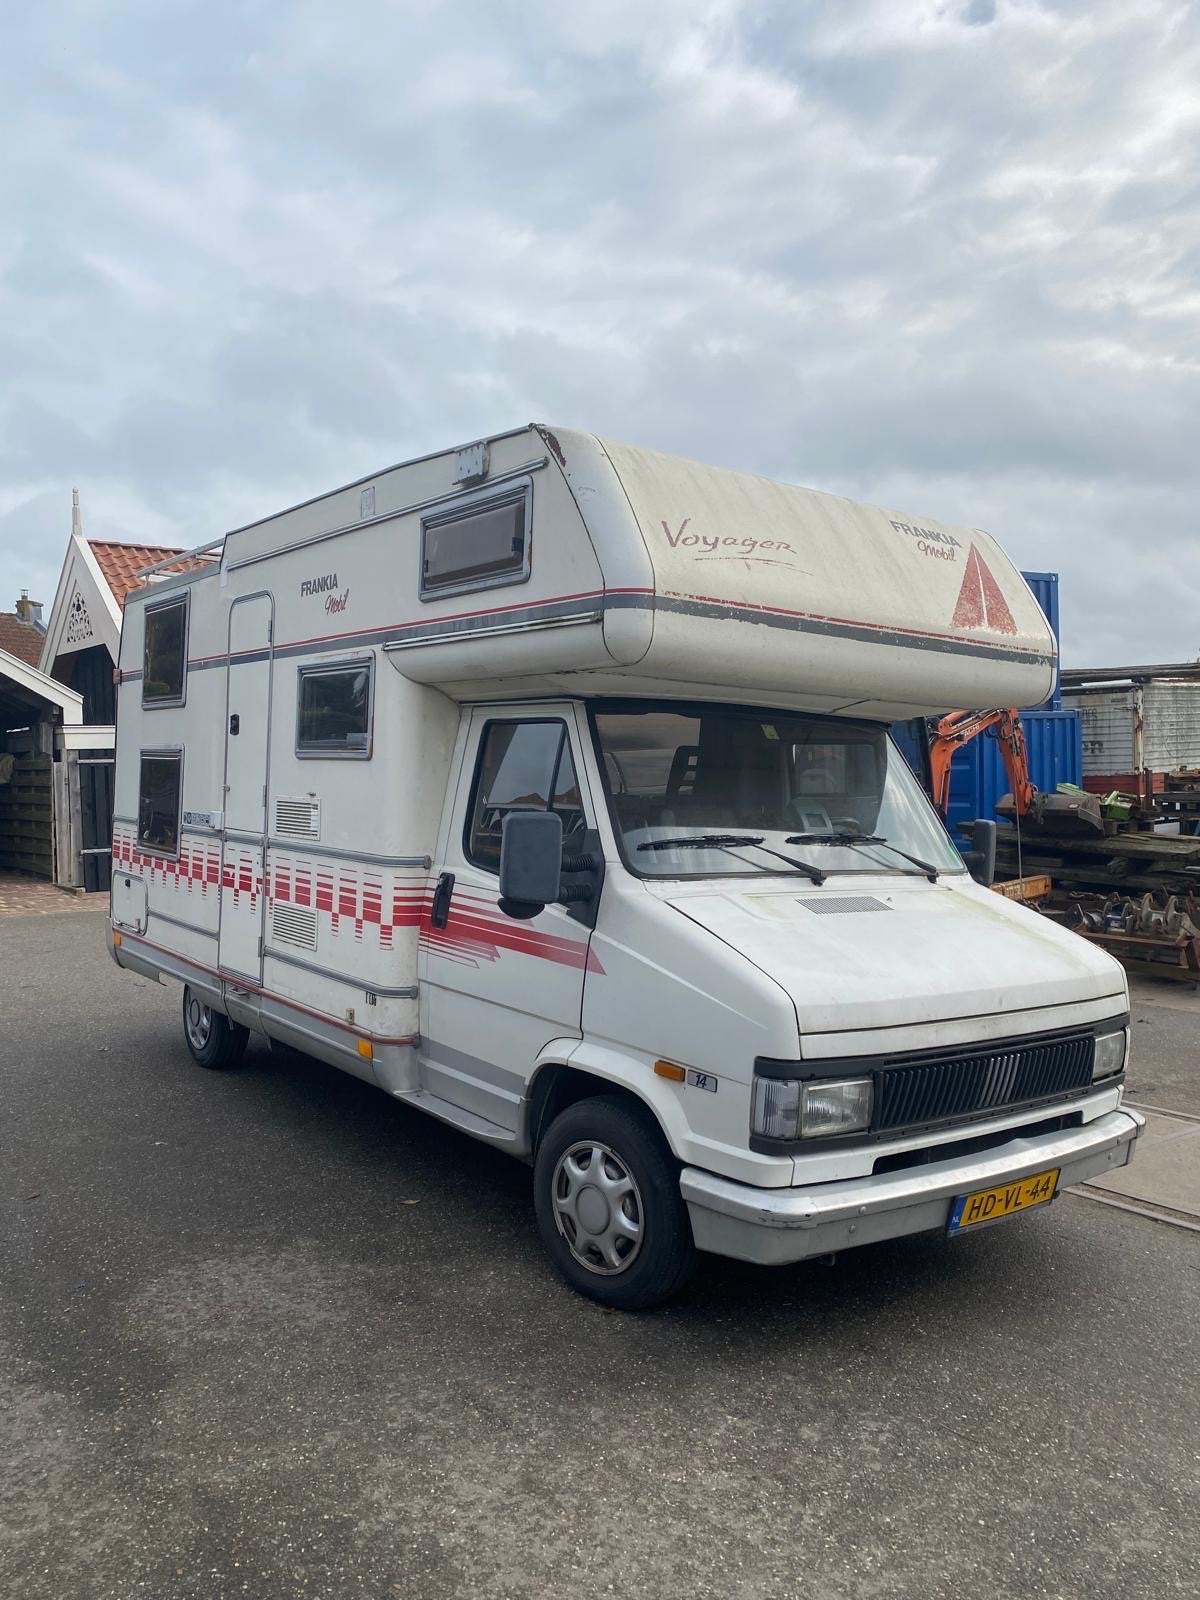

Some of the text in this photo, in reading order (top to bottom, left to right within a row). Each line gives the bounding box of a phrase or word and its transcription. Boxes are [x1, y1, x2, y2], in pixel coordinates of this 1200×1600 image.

[661, 517, 798, 554] Voyager
[889, 520, 963, 548] FRANKIA
[917, 540, 957, 562] Mobil
[300, 573, 338, 597] FRANKIA
[696, 1074, 707, 1088] 14
[967, 1175, 1052, 1221] HD-VL-44
[951, 1216, 960, 1224] NL
